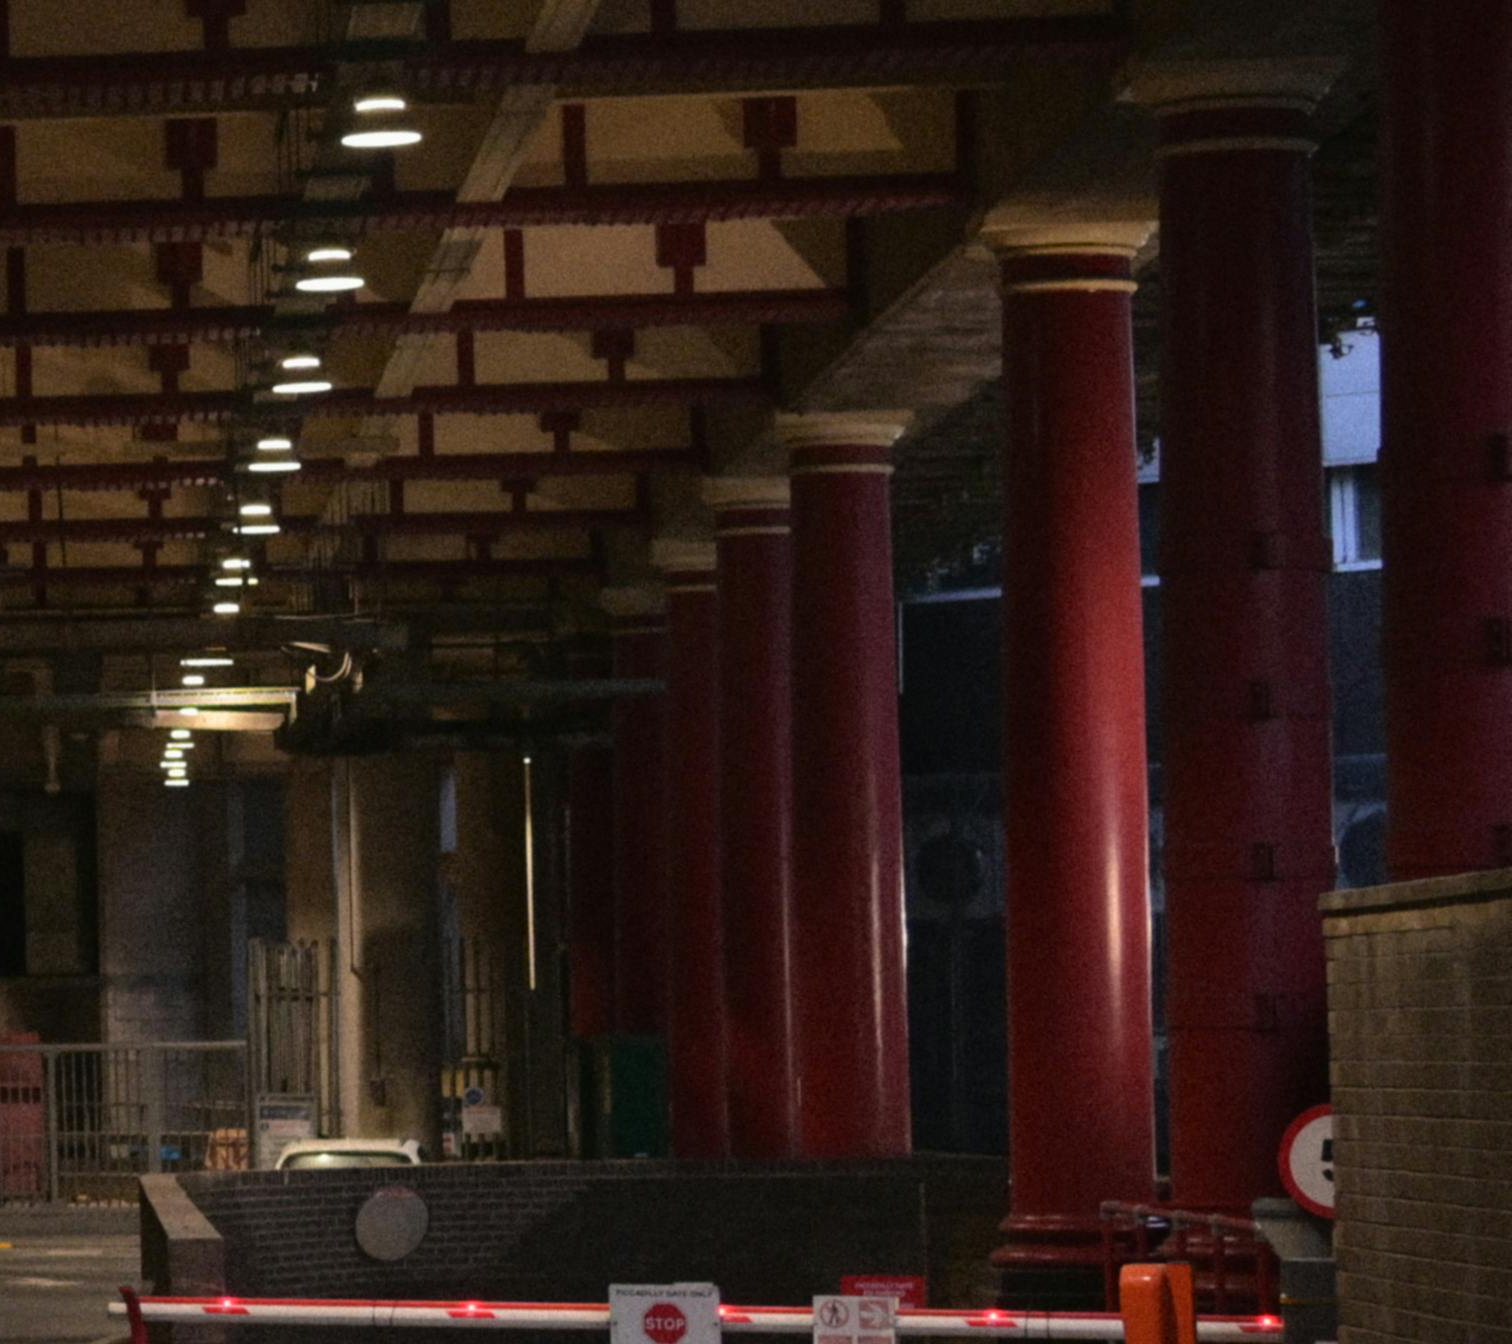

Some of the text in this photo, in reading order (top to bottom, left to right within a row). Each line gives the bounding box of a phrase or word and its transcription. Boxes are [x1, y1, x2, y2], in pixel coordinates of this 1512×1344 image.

[615, 1288, 713, 1298] PICCADILLY GATE ONLY
[645, 1316, 685, 1330] STOP
